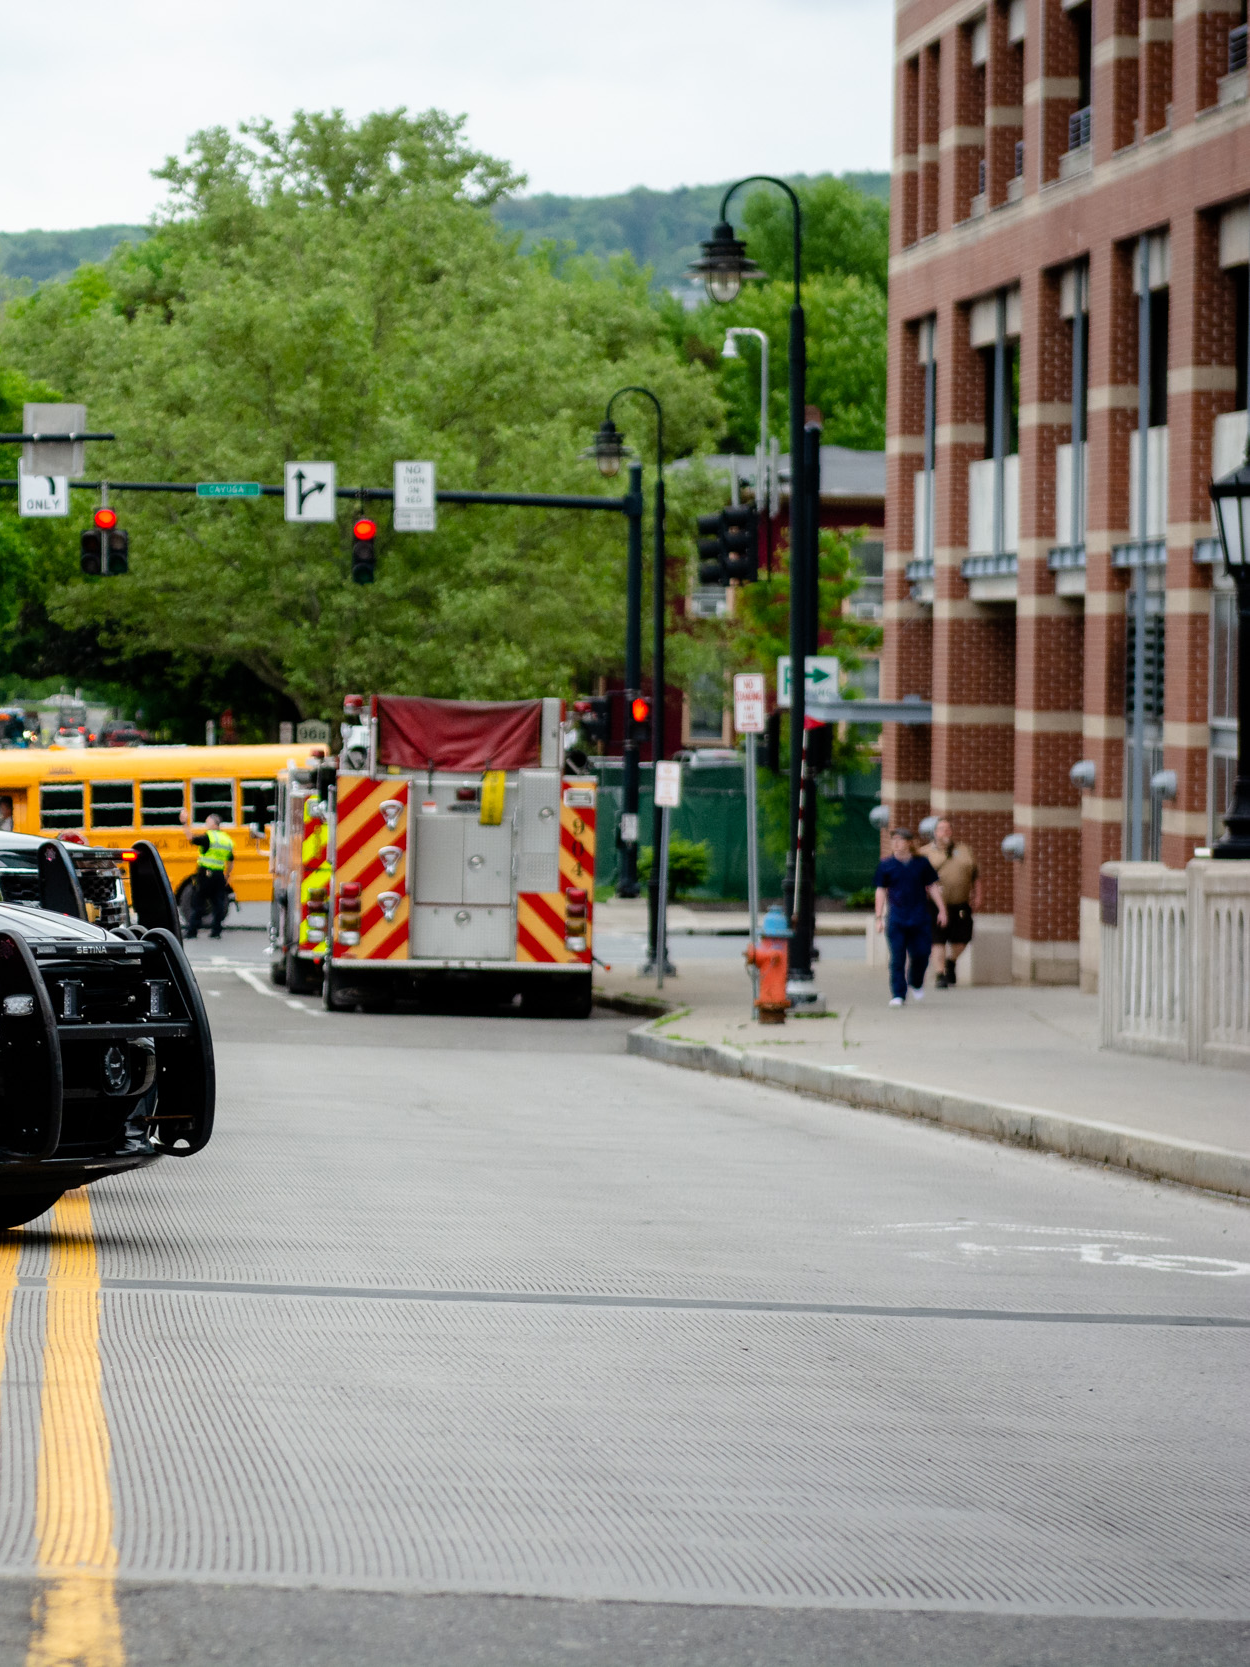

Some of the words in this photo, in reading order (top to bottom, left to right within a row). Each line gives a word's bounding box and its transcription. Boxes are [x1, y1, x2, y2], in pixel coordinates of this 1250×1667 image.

[405, 465, 421, 474] NO
[403, 476, 425, 485] TURN
[209, 485, 244, 493] CAYUGA
[26, 498, 60, 510] ONLY
[743, 679, 754, 689] NO
[571, 818, 586, 877] 904
[76, 945, 108, 954] SETINA
